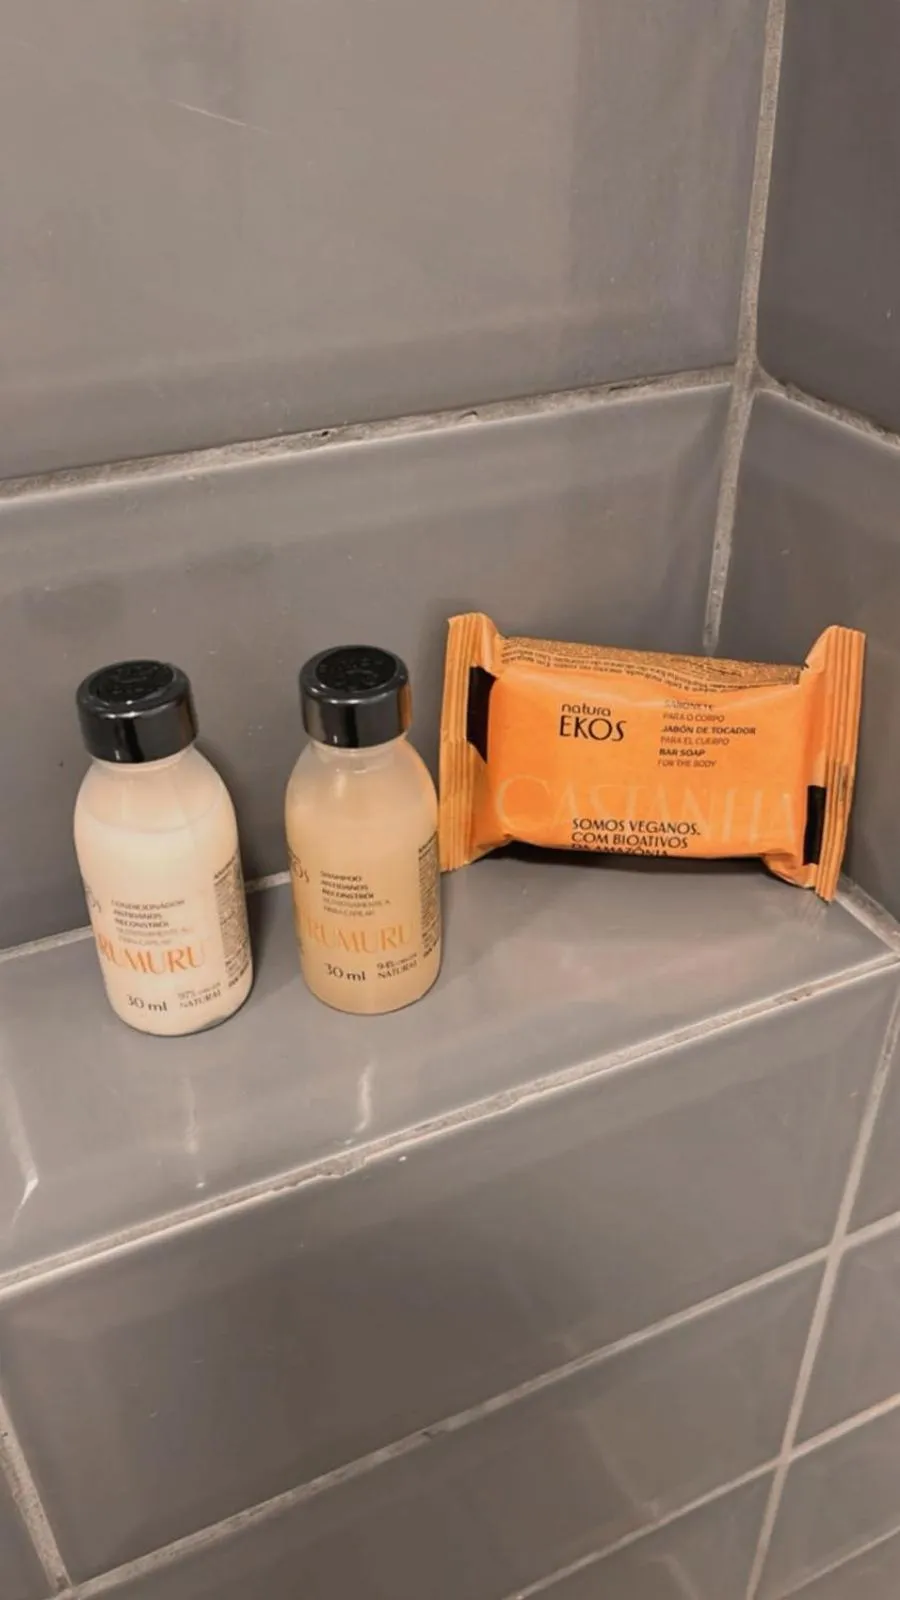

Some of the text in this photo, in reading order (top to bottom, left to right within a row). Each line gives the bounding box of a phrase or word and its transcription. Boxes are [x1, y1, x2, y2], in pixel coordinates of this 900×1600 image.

[561, 703, 611, 717] natura
[695, 714, 726, 723] CORPO
[559, 715, 627, 742] EKOS
[696, 726, 708, 734] DE
[711, 726, 756, 736] TOCADOR
[683, 737, 693, 745] EL
[695, 737, 730, 746] CUERPO
[659, 748, 706, 757] BAR SOAP
[676, 759, 691, 767] THE
[692, 760, 717, 768] BODY
[495, 774, 798, 846] CASTANHA
[572, 818, 625, 832] SOMOS
[571, 832, 688, 849] COM BIOATIVOS
[324, 962, 366, 982] 30 ml
[126, 994, 168, 1012] 30 ml
